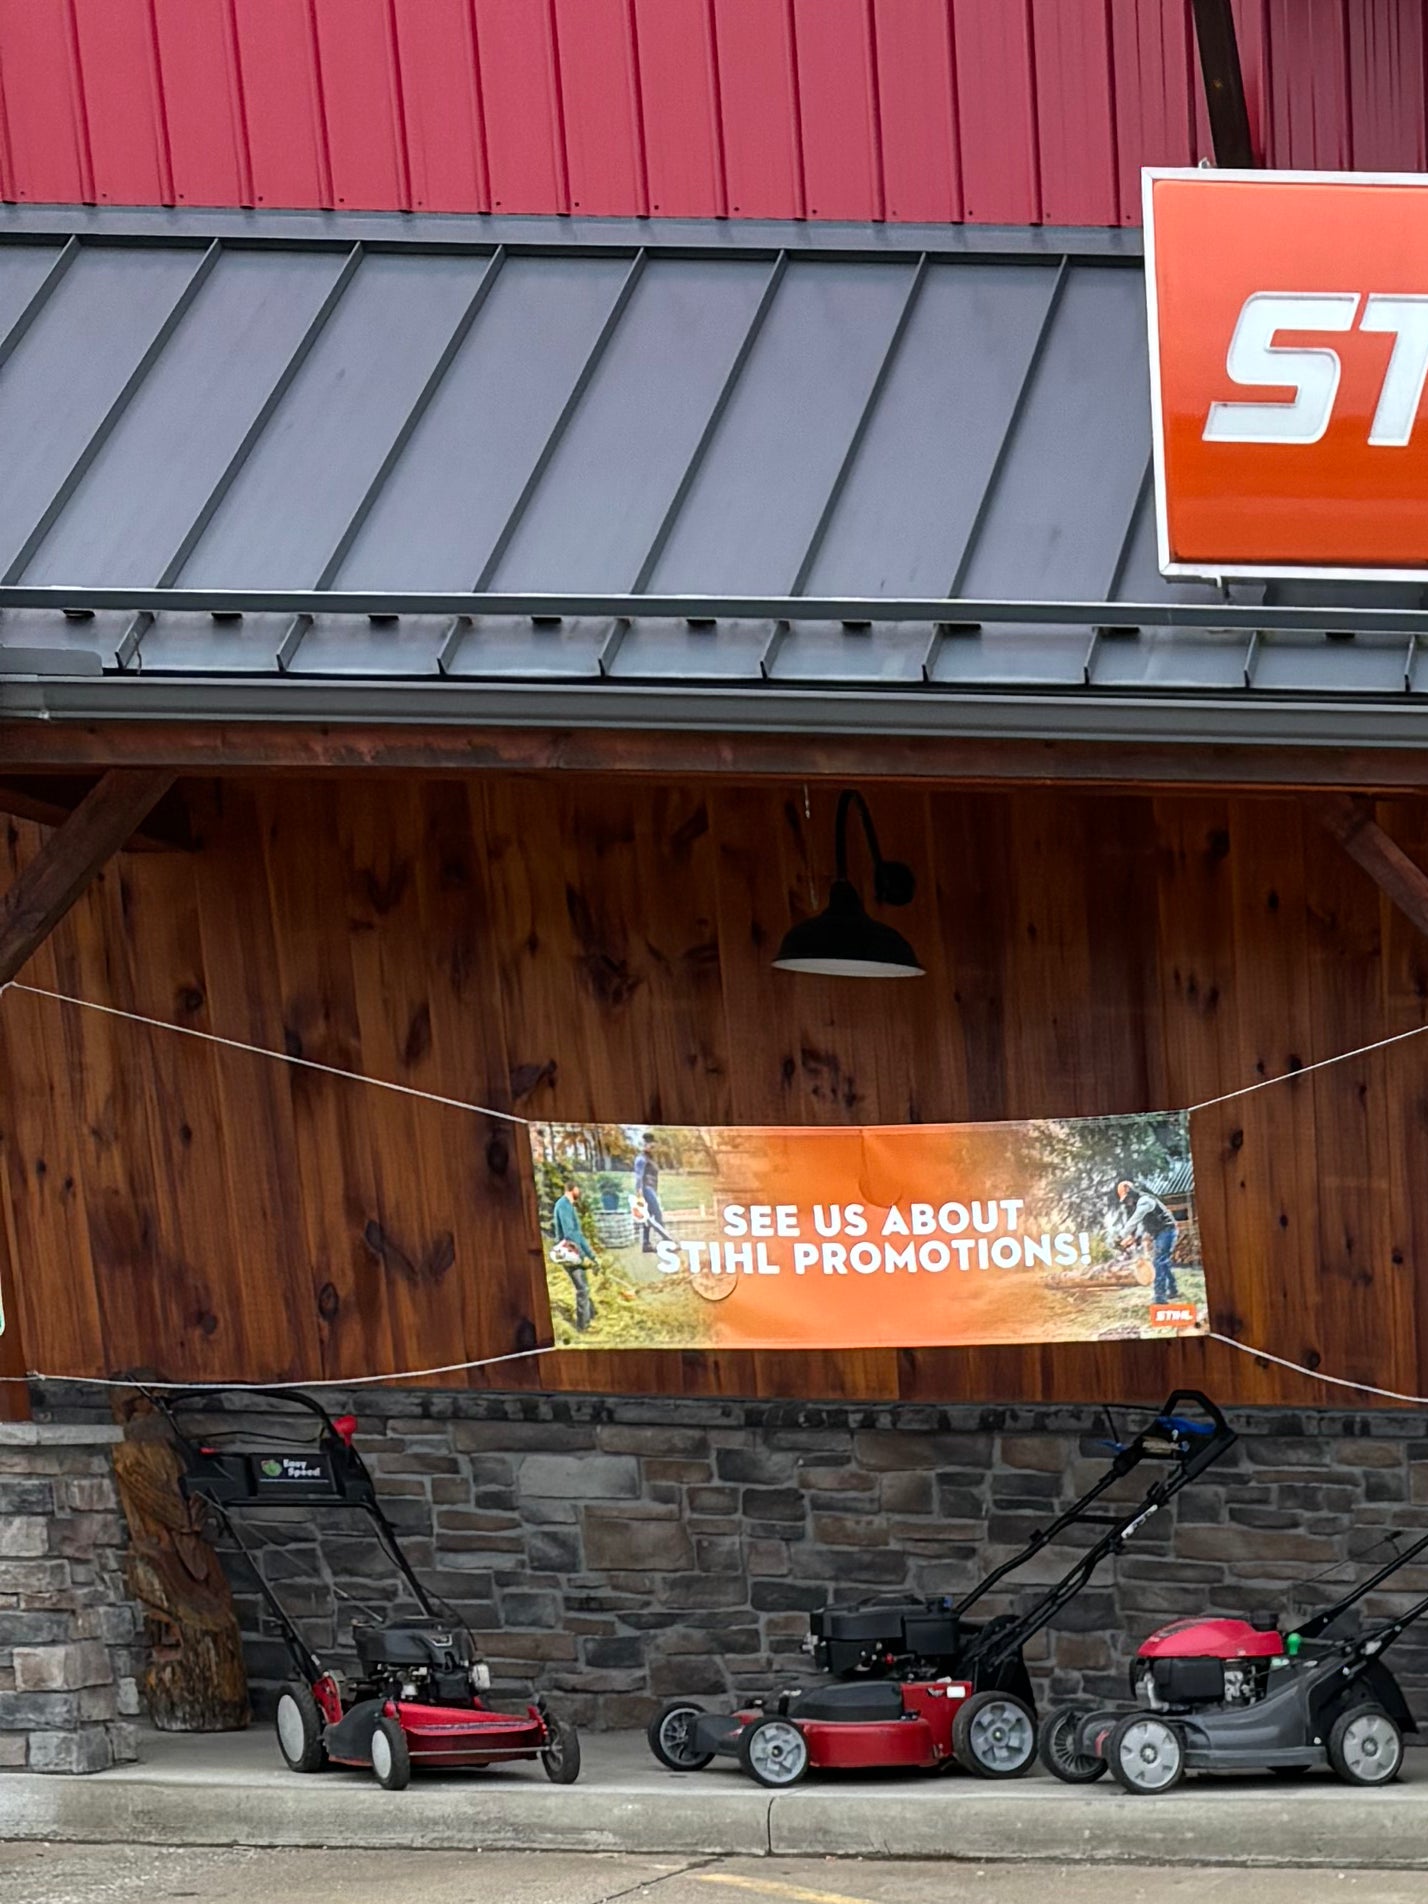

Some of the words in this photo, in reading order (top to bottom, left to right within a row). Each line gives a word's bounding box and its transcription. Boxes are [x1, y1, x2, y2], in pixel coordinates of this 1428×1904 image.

[723, 1204, 800, 1237] SEE
[813, 1203, 868, 1237] US
[881, 1199, 1024, 1237] ABOUT
[656, 1239, 780, 1274] STIHL
[793, 1232, 1092, 1275] PROMOTIONS!
